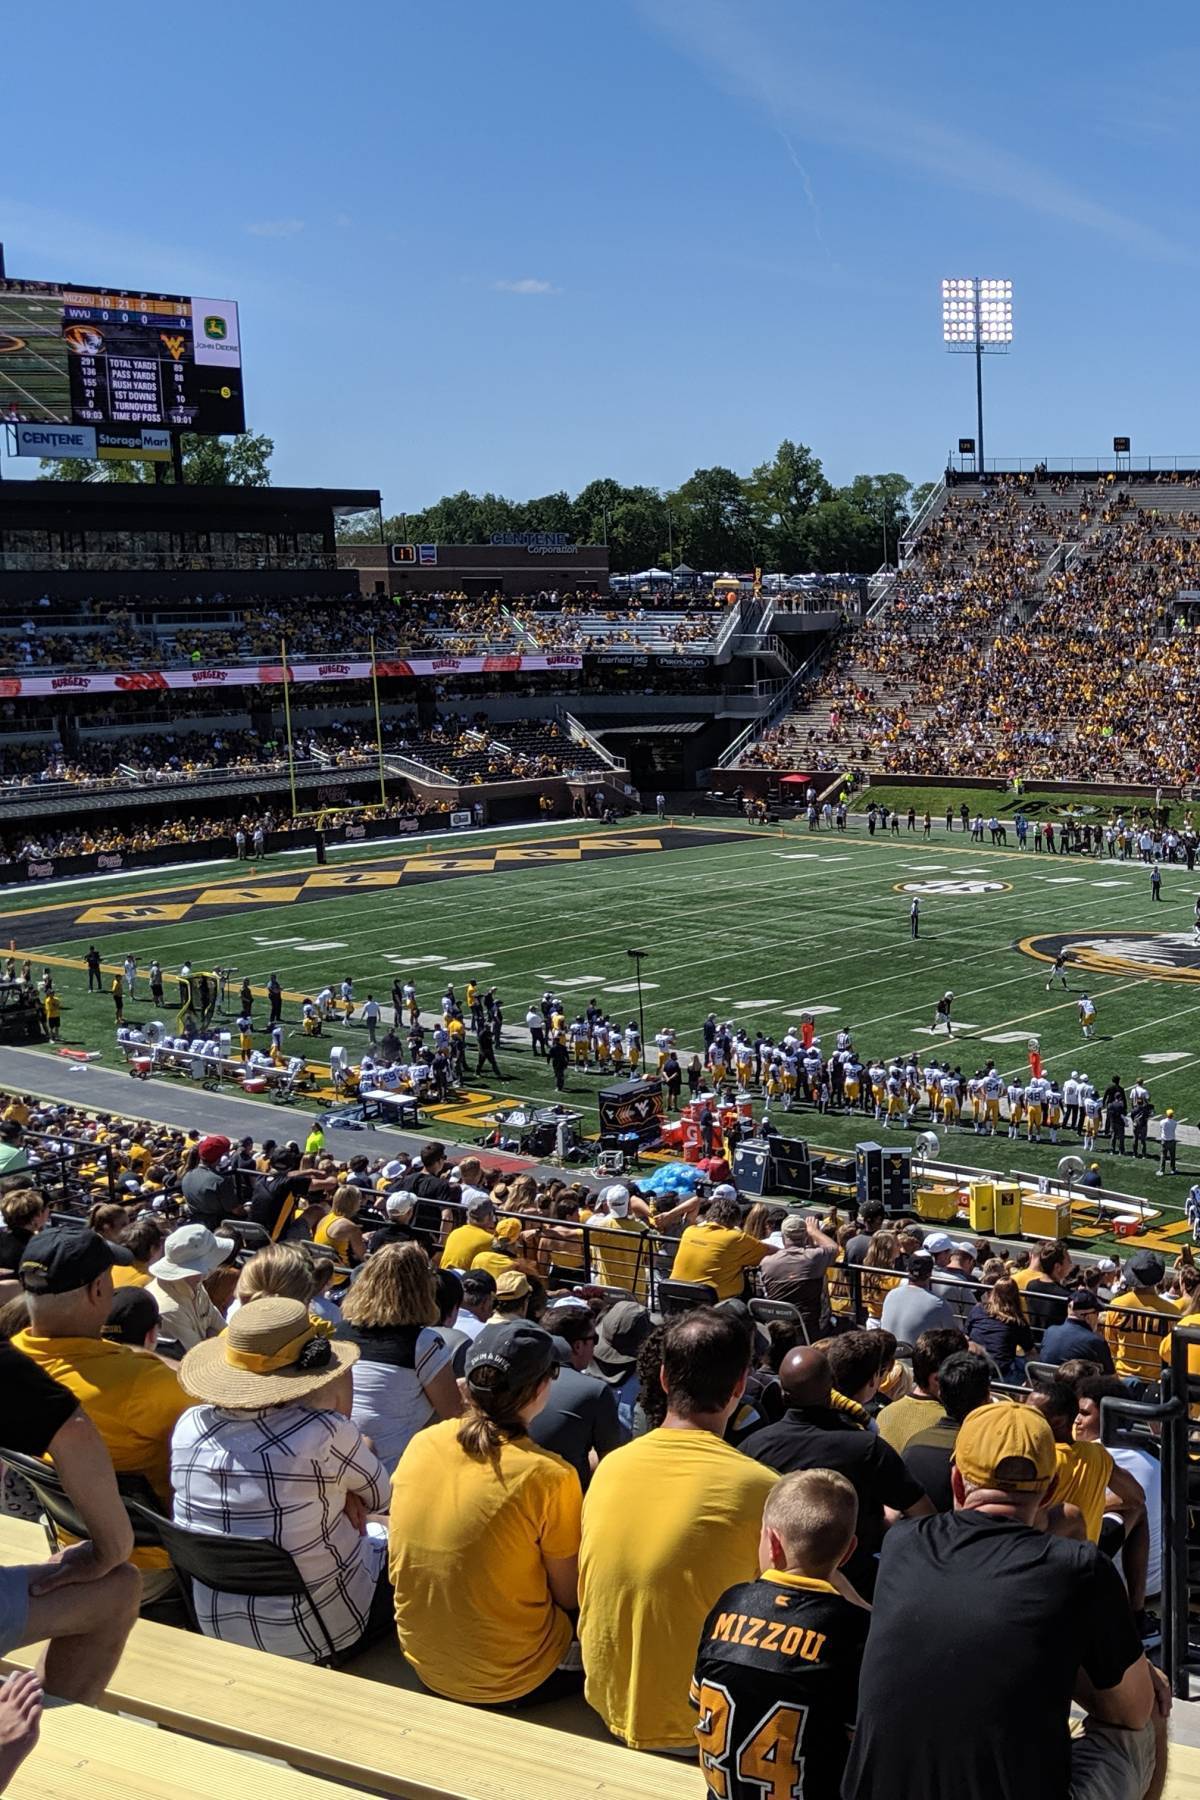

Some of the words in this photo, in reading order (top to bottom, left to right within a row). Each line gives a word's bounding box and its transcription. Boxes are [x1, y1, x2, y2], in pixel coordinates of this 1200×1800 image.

[69, 308, 91, 319] WVU
[102, 311, 109, 321] 0
[122, 313, 129, 322] 0
[141, 315, 148, 324] 0
[180, 318, 186, 328] 0
[195, 343, 214, 351] JOHN
[215, 344, 238, 352] DEERE
[109, 359, 132, 368] TOTAL
[133, 361, 157, 370] YARDS
[112, 370, 131, 379] PASS
[132, 372, 156, 381] YARDS
[112, 381, 132, 389] RUSH
[133, 382, 157, 391] YARDS
[115, 391, 128, 399] 1ST
[128, 392, 157, 401] DOWNS
[115, 401, 157, 412] TURNOVERS
[112, 412, 131, 421] TIME
[131, 413, 142, 421] OF
[142, 414, 161, 423] POSS
[22, 432, 84, 447] CENTENE
[491, 532, 567, 545] CENTENE
[528, 544, 578, 555] Corporation
[711, 1612, 826, 1661] MIZZOU
[697, 1677, 810, 1800] 24
